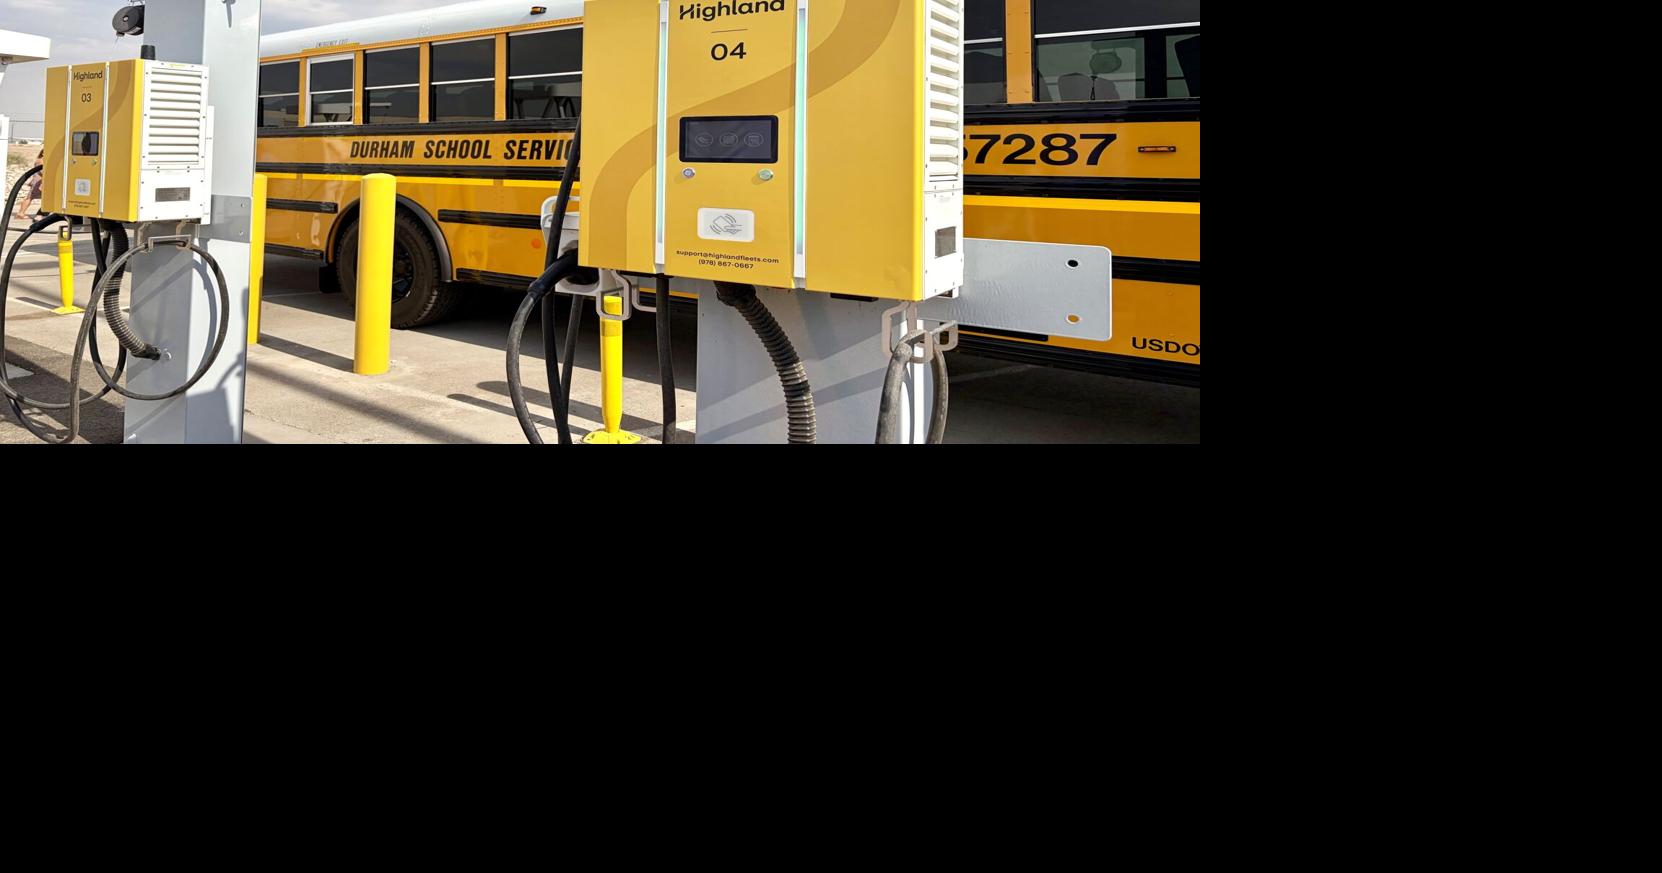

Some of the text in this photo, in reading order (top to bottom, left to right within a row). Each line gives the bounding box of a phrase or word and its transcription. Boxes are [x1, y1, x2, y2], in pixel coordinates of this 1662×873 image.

[679, 0, 785, 22] Highland
[710, 42, 747, 61] 04
[73, 70, 103, 82] Highland
[81, 93, 92, 103] 03
[350, 140, 415, 159] DURHAM
[423, 139, 492, 159] SCHOOL
[963, 133, 1117, 166] 7287
[676, 250, 780, 264] support@highlandfleets.com
[698, 258, 716, 267] (978)
[1131, 336, 1200, 356] USDO
